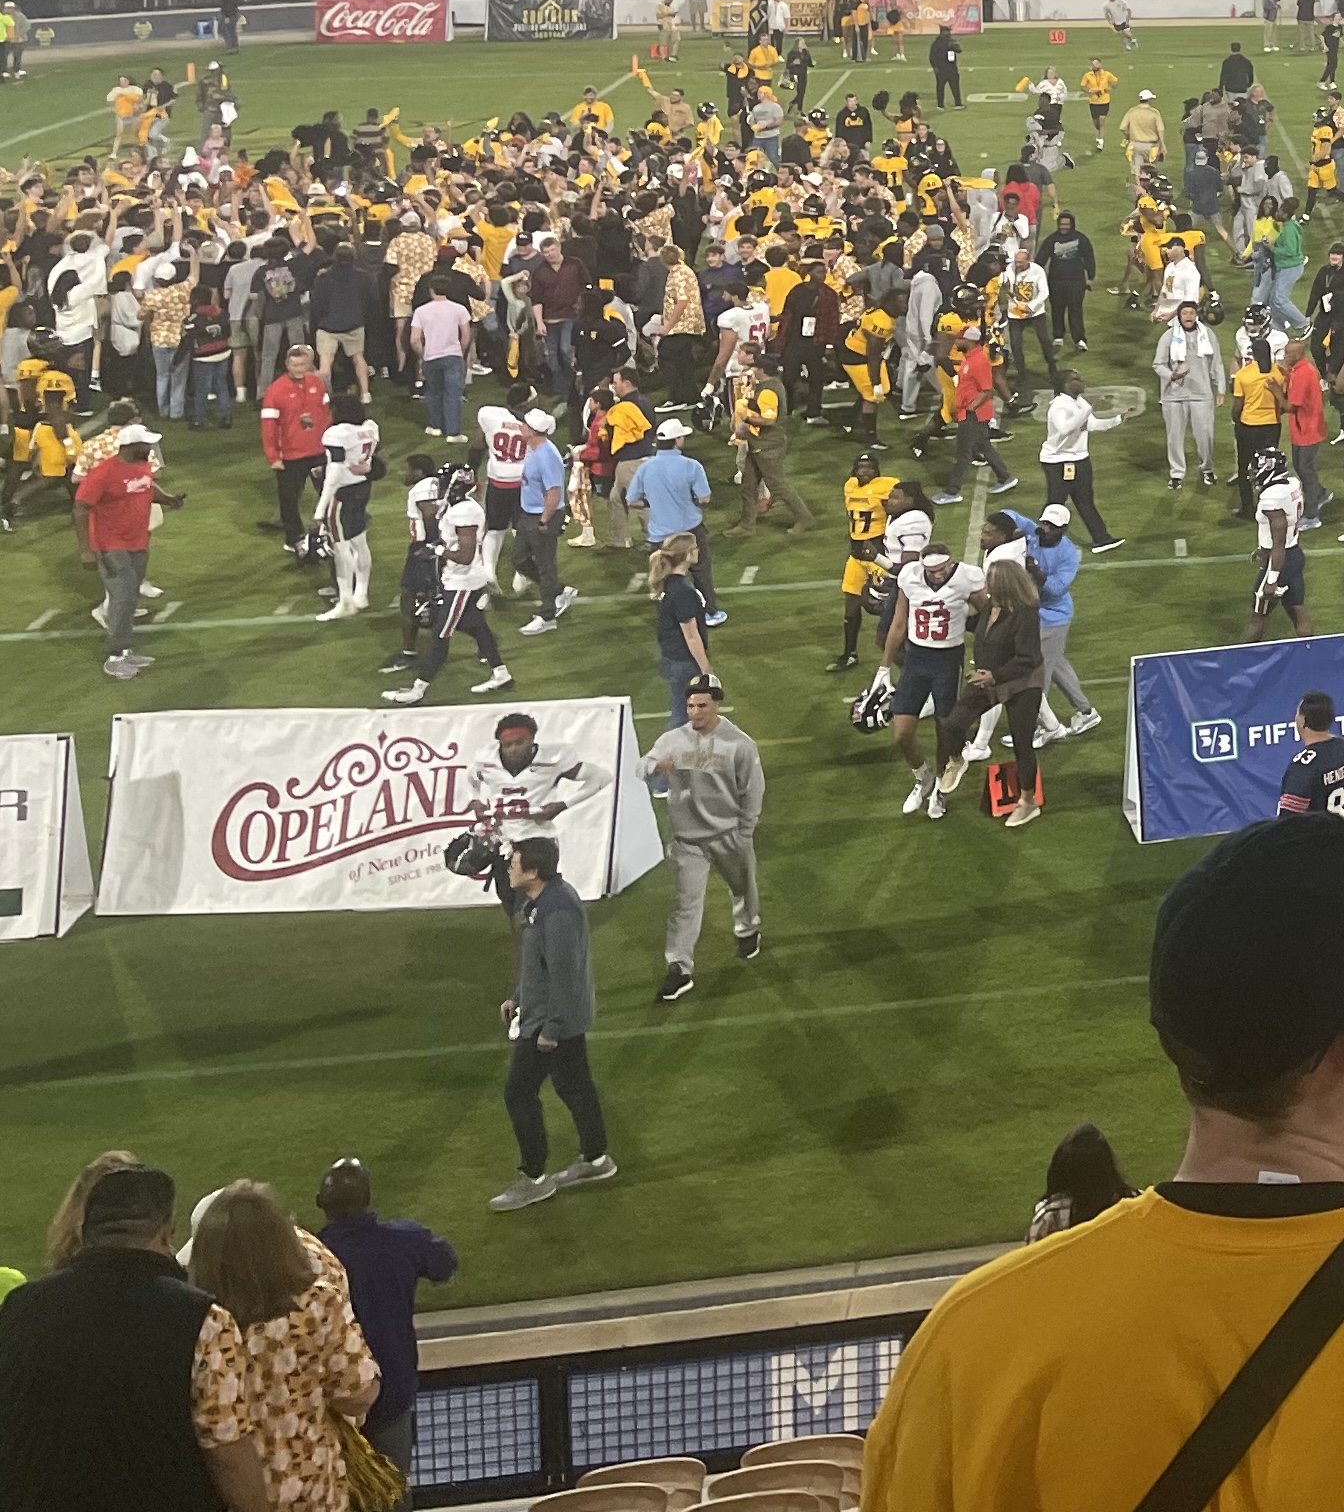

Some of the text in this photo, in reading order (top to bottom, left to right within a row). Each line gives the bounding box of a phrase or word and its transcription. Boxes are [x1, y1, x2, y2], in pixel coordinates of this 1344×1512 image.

[320, 1, 440, 37] Coca-Cola
[493, 431, 528, 464] 90
[915, 608, 951, 641] 83
[1248, 720, 1300, 748] FIFT
[211, 764, 468, 883] COPELAN
[348, 842, 442, 883] of New Orle
[387, 869, 422, 887] SINCE
